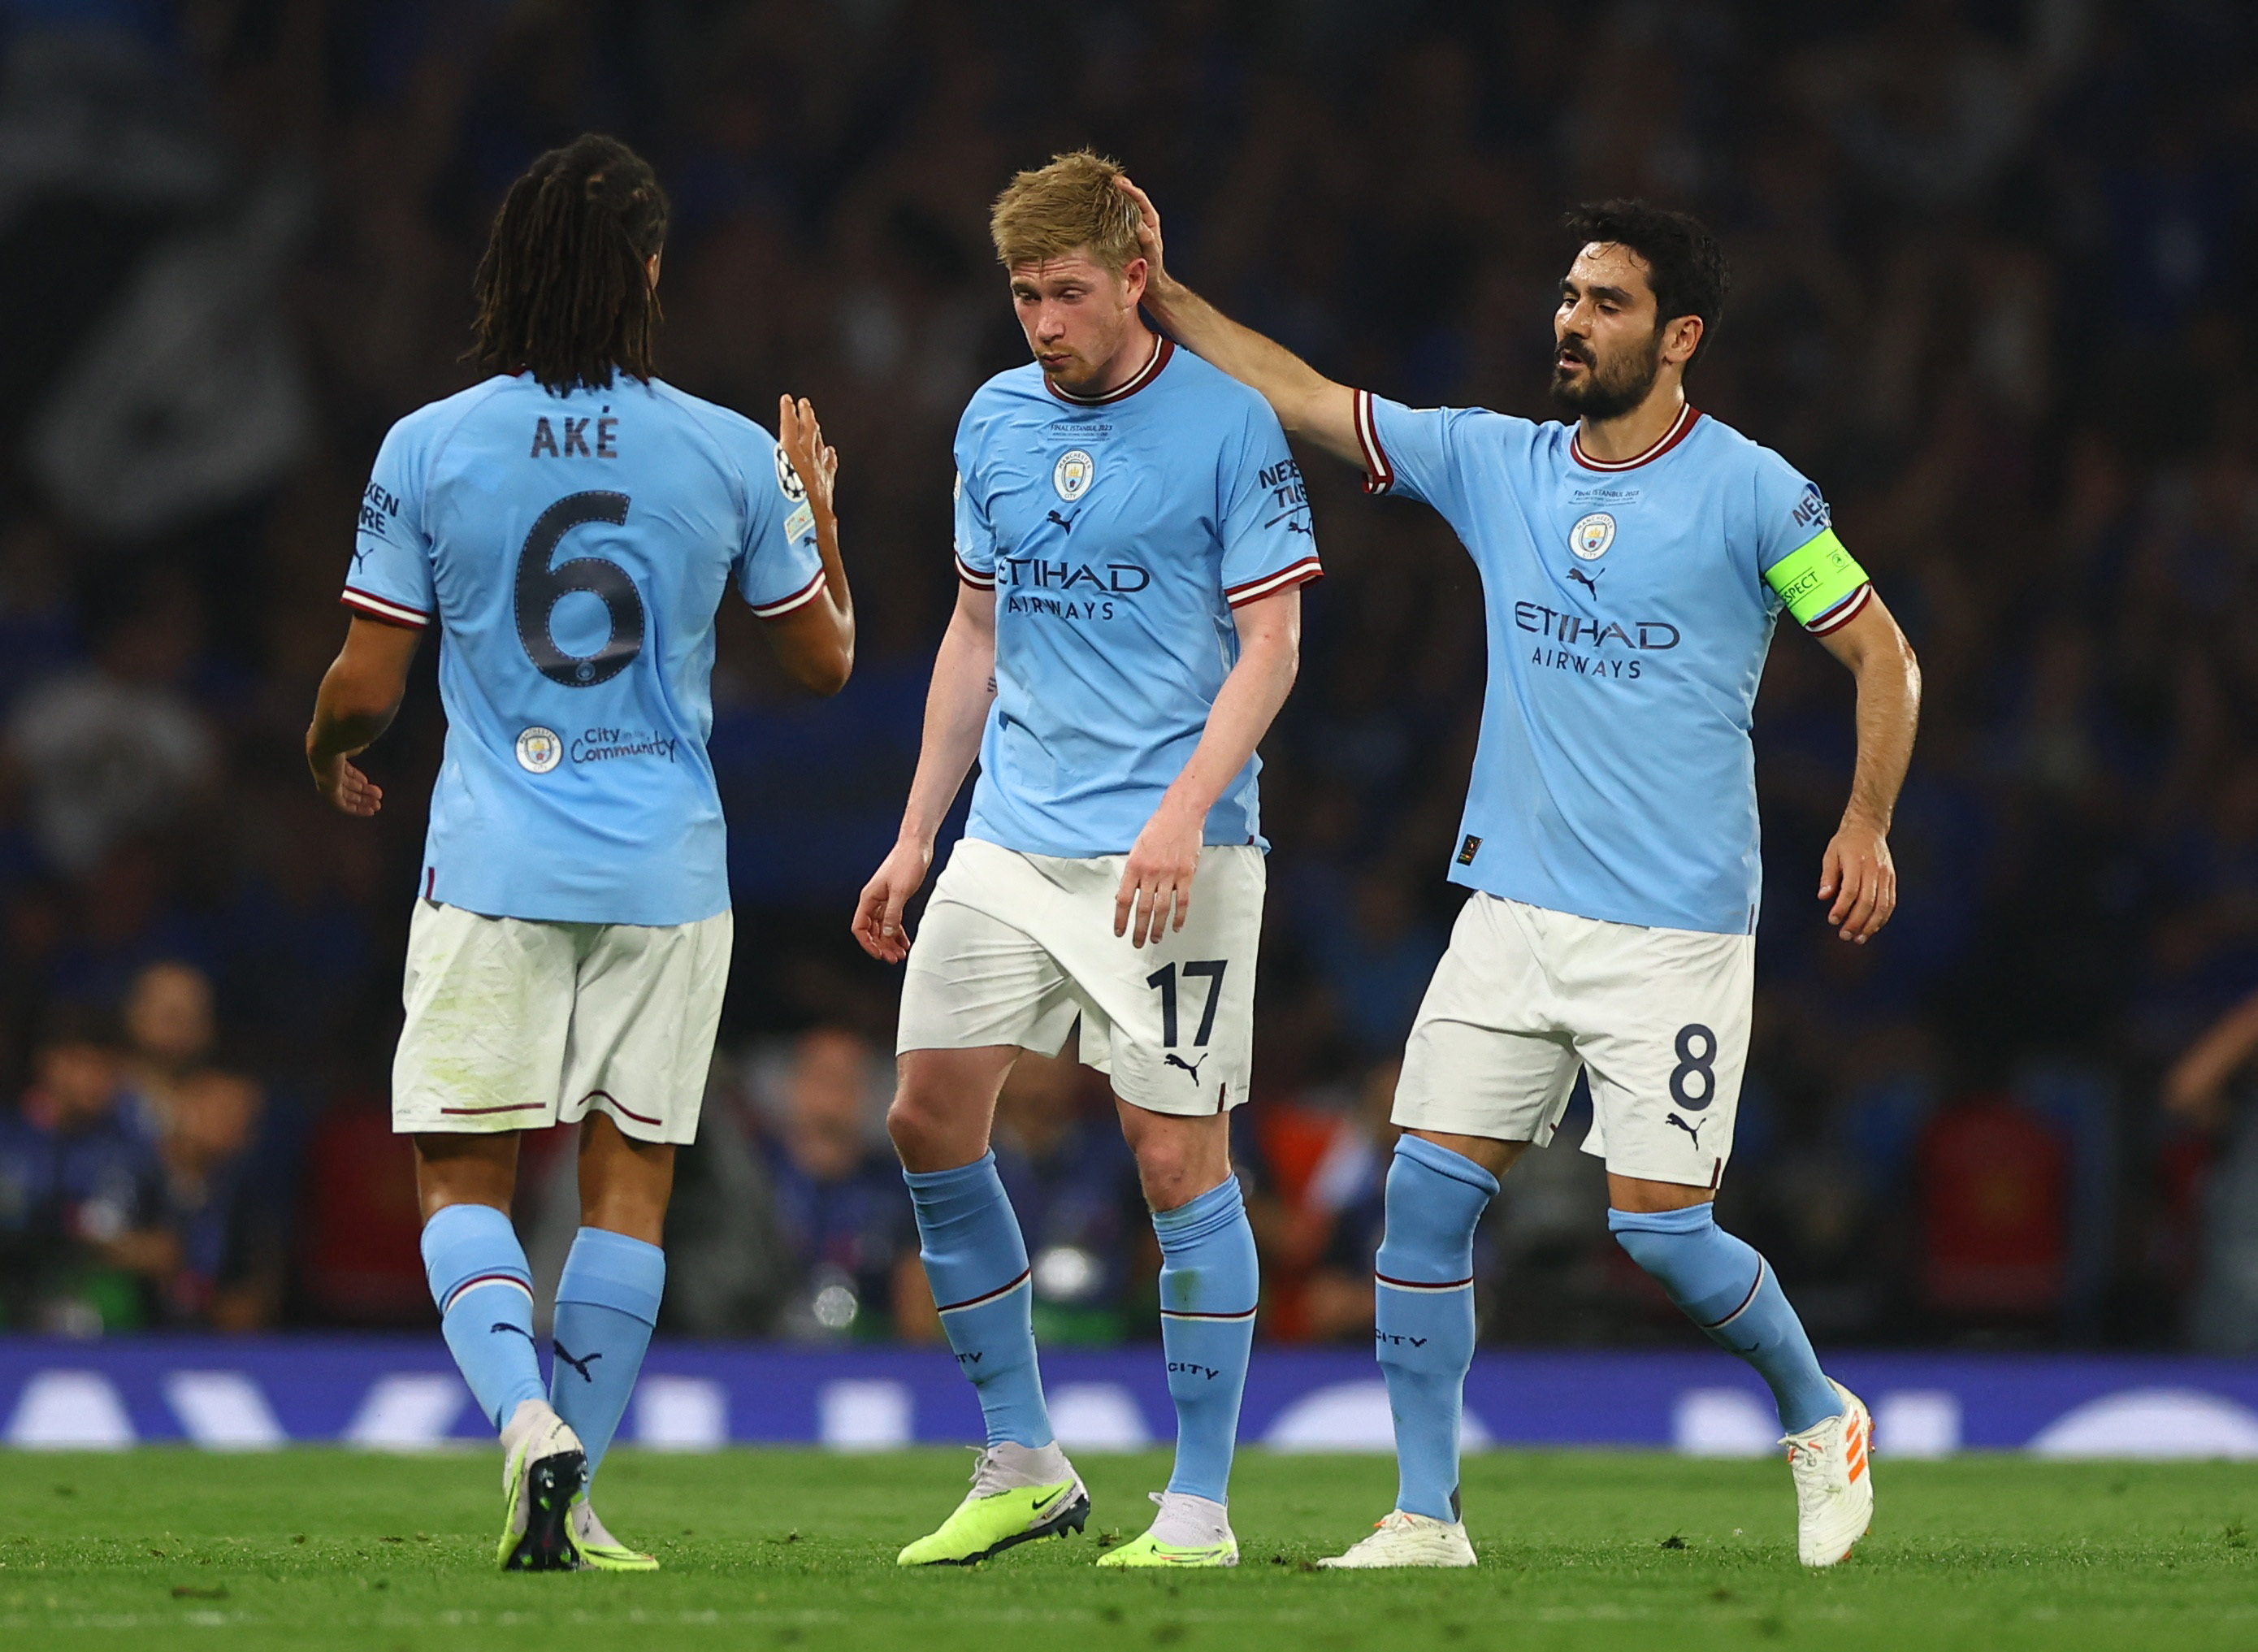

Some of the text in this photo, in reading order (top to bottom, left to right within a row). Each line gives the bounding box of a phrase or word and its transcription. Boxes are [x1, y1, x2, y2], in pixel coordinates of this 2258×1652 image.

[531, 405, 618, 457] AKÉ
[1059, 453, 1091, 469] MANCHESTER
[1576, 516, 1613, 531] MANCHESTER
[514, 489, 645, 687] 6
[998, 557, 1151, 592] ETIHAD
[1008, 596, 1114, 621] AIRWAYS
[1515, 601, 1680, 649] ETIHAD
[1532, 647, 1640, 679] AIRWAYS
[570, 730, 675, 763] Community
[584, 727, 620, 744] City
[1146, 960, 1229, 1047] 17
[1669, 1023, 1717, 1112] 8
[1168, 1362, 1219, 1380] CITY
